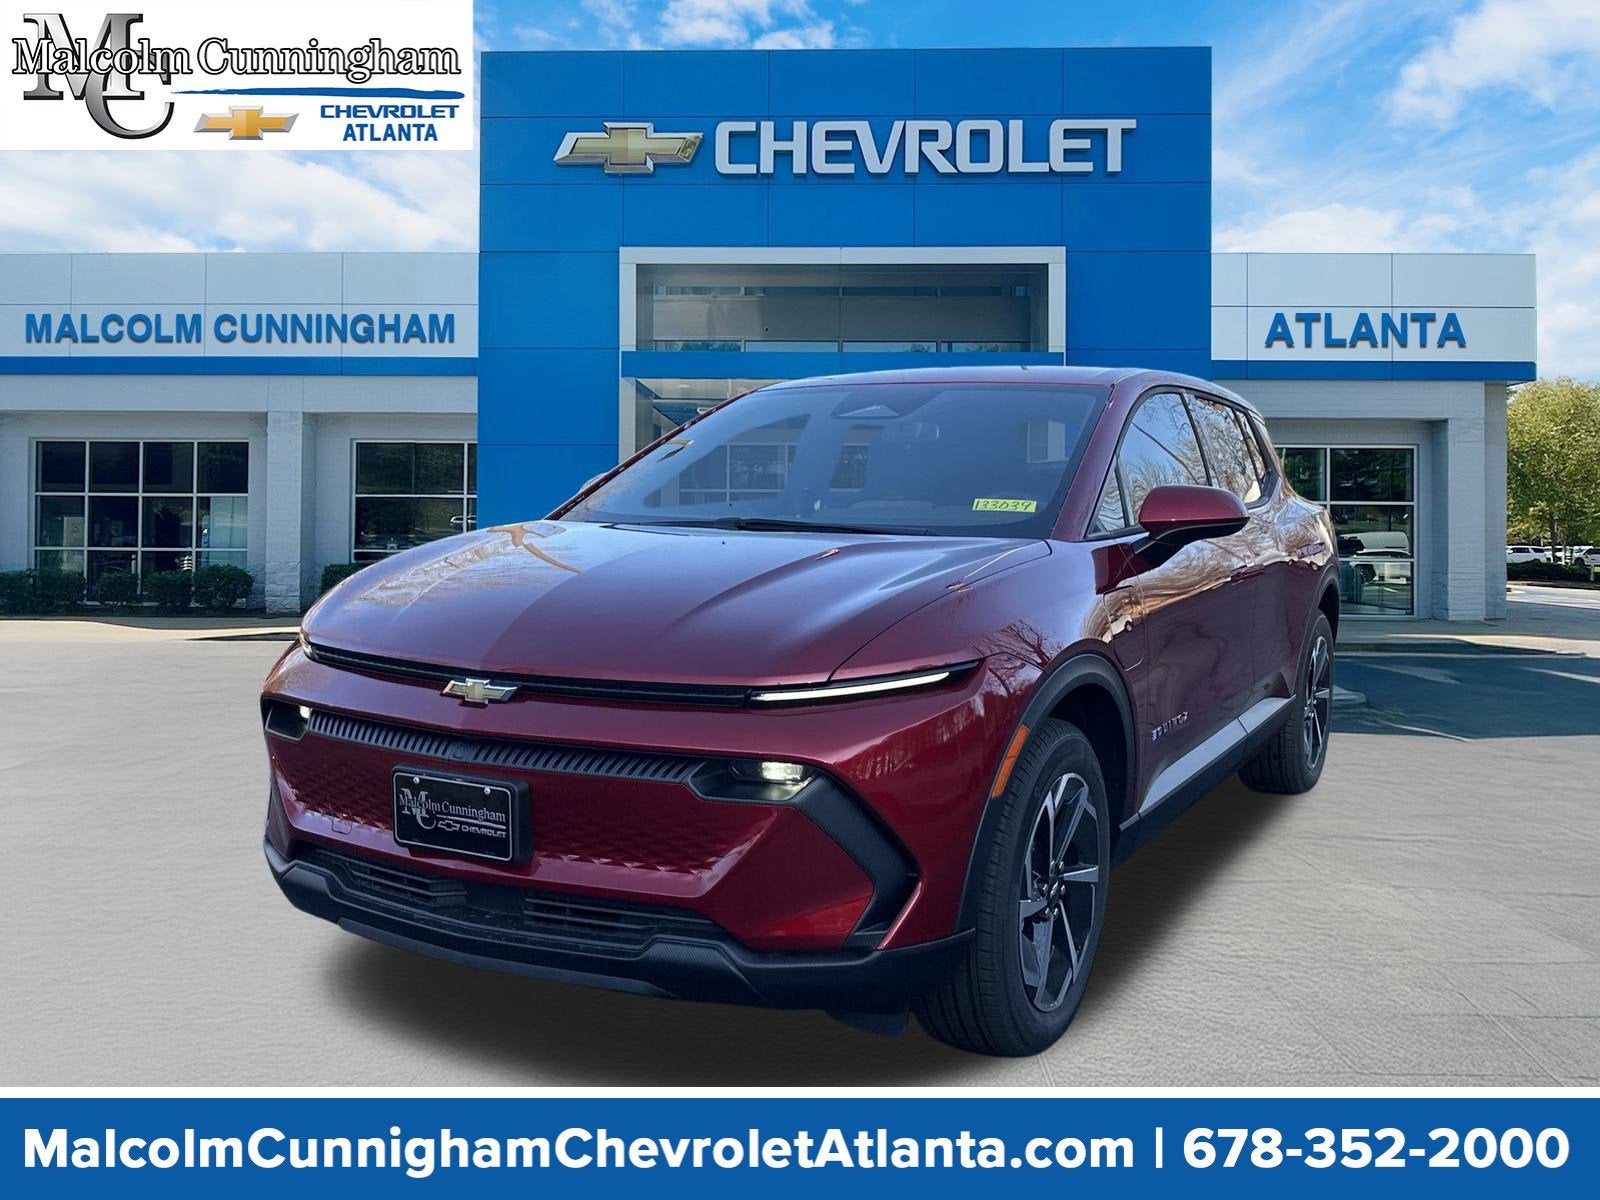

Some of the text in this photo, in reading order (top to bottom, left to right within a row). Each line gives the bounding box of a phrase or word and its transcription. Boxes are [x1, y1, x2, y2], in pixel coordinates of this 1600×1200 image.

[714, 118, 1137, 175] CHEVROLET
[25, 313, 456, 343] MALCOLM CUNNINGHAM
[1264, 312, 1467, 348] ATLANTA
[399, 793, 506, 823] Malcolm Cunningham
[461, 824, 507, 838] CHEVROLET
